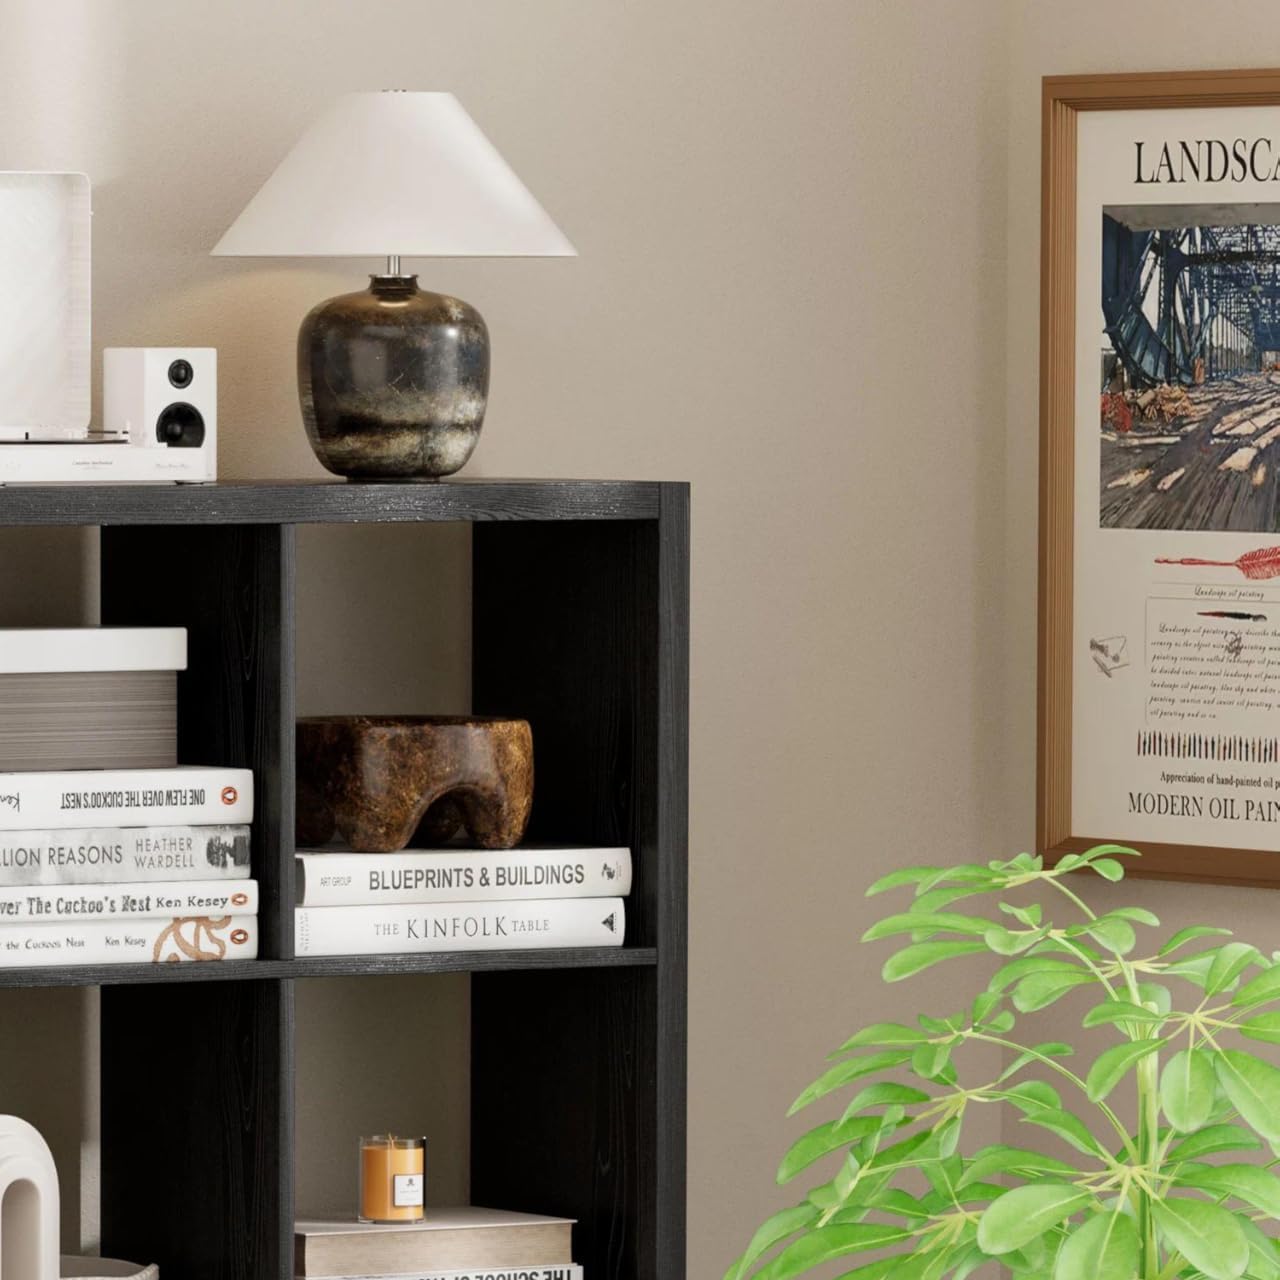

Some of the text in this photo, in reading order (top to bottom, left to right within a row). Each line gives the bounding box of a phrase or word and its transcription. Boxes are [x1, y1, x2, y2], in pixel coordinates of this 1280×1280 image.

[60, 788, 205, 809] ONE FLEW OVER THE CUCKOO'S NEST
[1128, 791, 1203, 817] MODERN
[1209, 797, 1240, 820] OIL
[135, 837, 193, 852] HEATHER
[48, 845, 123, 865] REASONS
[134, 854, 195, 869] WARDELL
[369, 864, 585, 891] BLUEPRINTS & BUILDINGS
[27, 897, 51, 915] The
[56, 896, 116, 914] Cuckoo's
[122, 895, 151, 912] Nest
[156, 897, 181, 908] Ken
[187, 896, 228, 909] Kesey
[374, 916, 550, 939] THE KINFOLK TABLE
[6, 940, 19, 950] the
[105, 937, 120, 946] Ken
